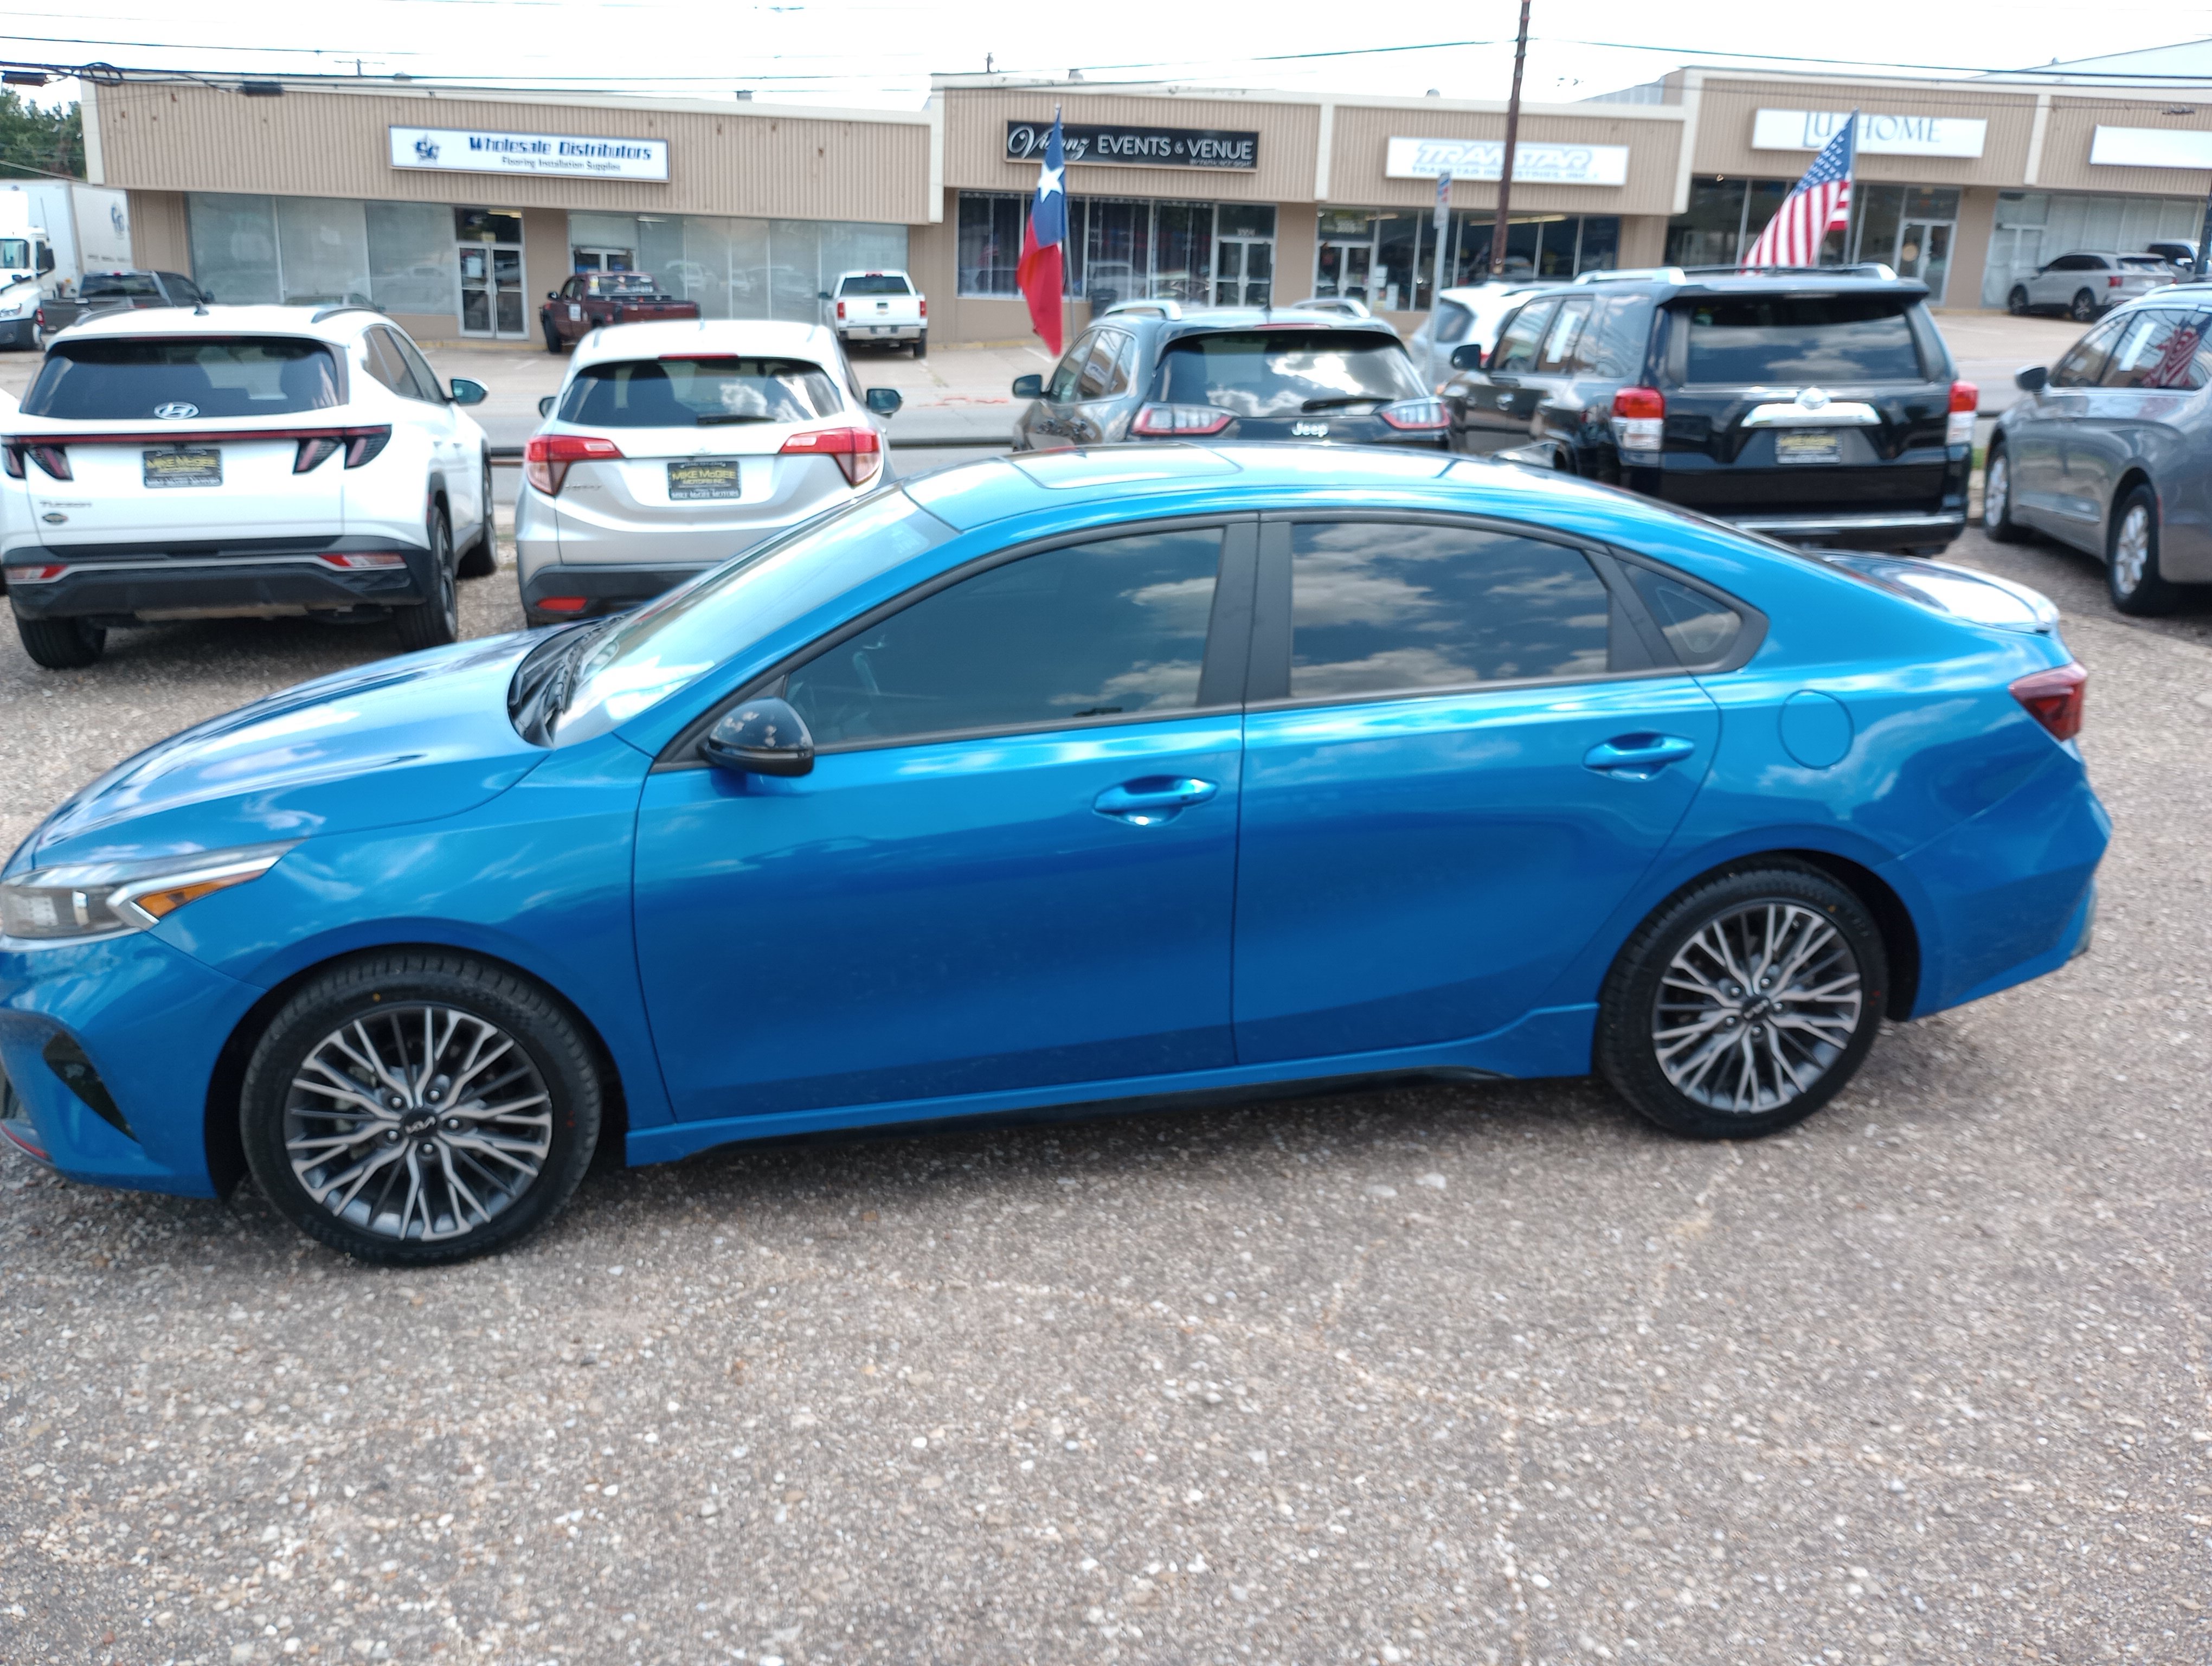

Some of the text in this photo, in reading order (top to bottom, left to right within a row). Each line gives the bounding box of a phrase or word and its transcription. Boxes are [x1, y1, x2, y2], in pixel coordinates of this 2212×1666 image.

[470, 137, 652, 161] Wholesale Distributors
[1097, 134, 1172, 157] EVENTS
[1174, 140, 1185, 155] &
[1187, 138, 1253, 161] VENUE
[503, 156, 621, 173] Flooring Installation Supplies
[1291, 421, 1329, 438] Jeep
[671, 470, 698, 481] MIKE
